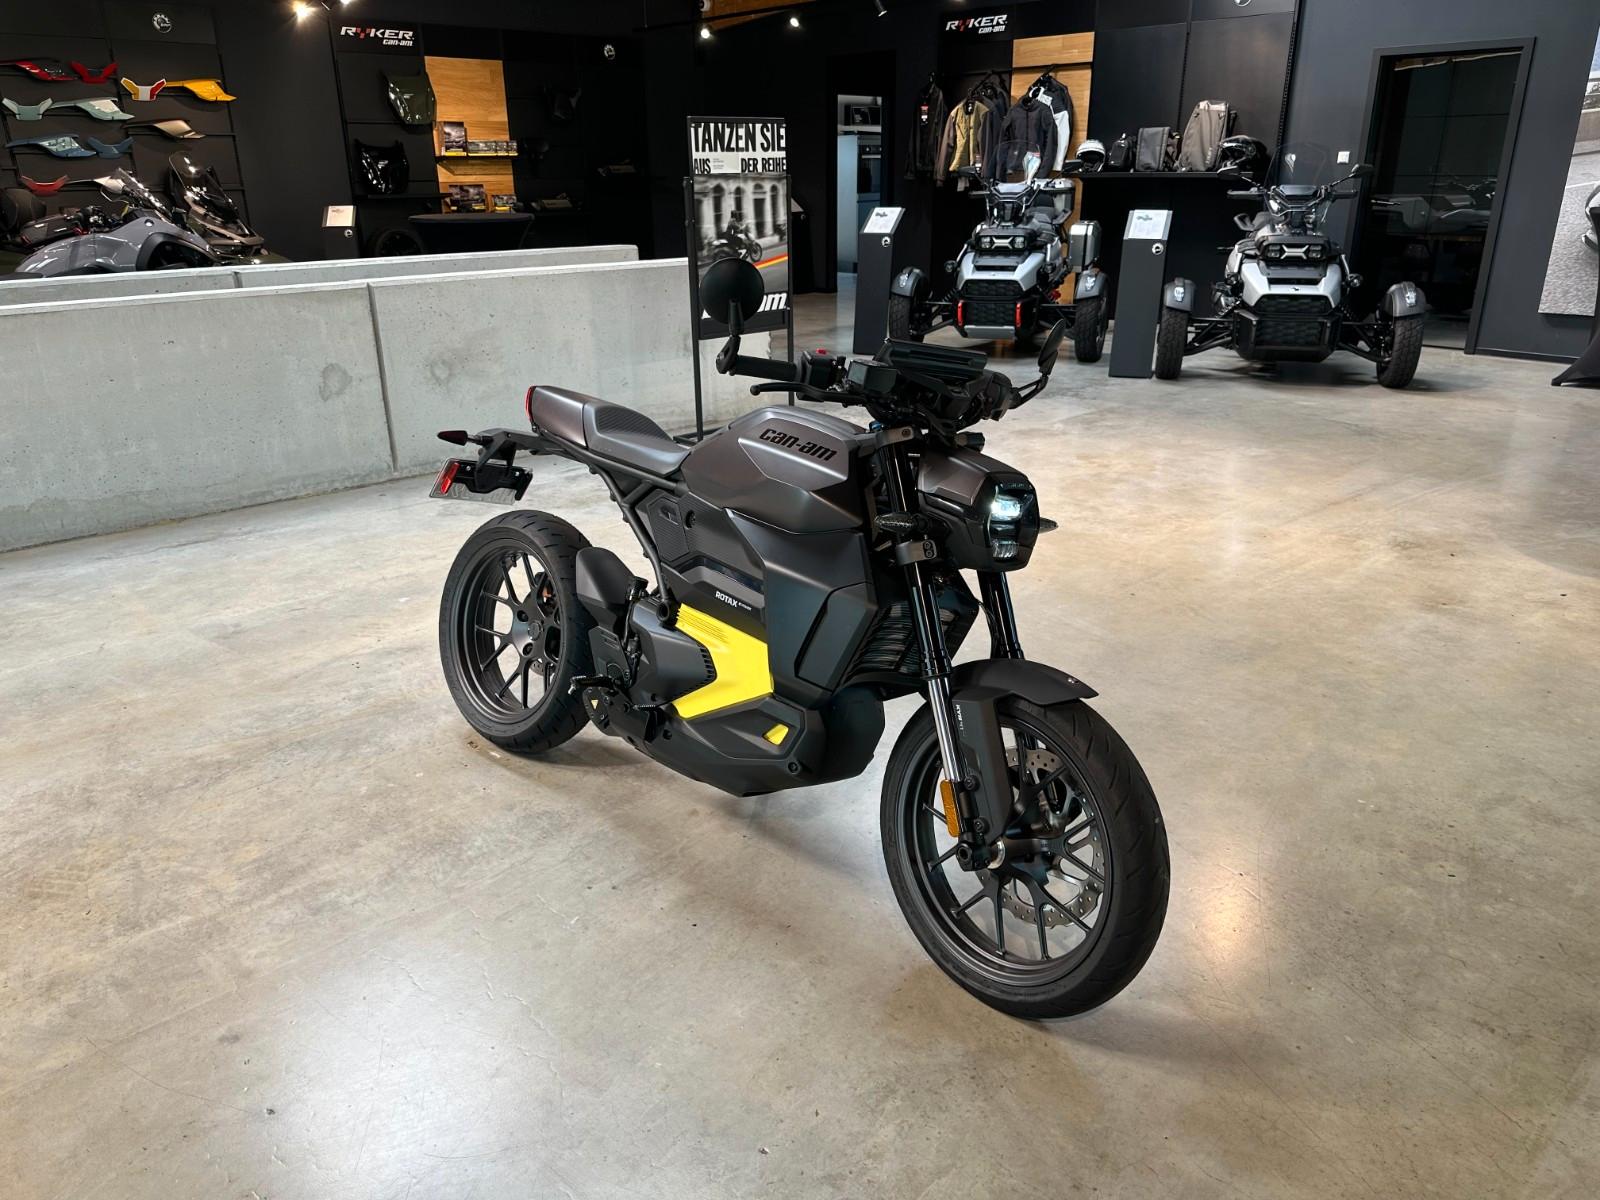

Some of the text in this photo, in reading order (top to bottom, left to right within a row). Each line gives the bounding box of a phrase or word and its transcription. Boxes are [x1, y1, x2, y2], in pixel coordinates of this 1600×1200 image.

[340, 26, 414, 40] RYKER
[382, 39, 413, 47] can-am
[691, 122, 786, 153] TANZEN SIE
[693, 158, 711, 175] AUS
[740, 157, 758, 173] DER
[762, 157, 787, 173] REIHE
[759, 428, 837, 461] can-am
[715, 590, 738, 608] ROTAX
